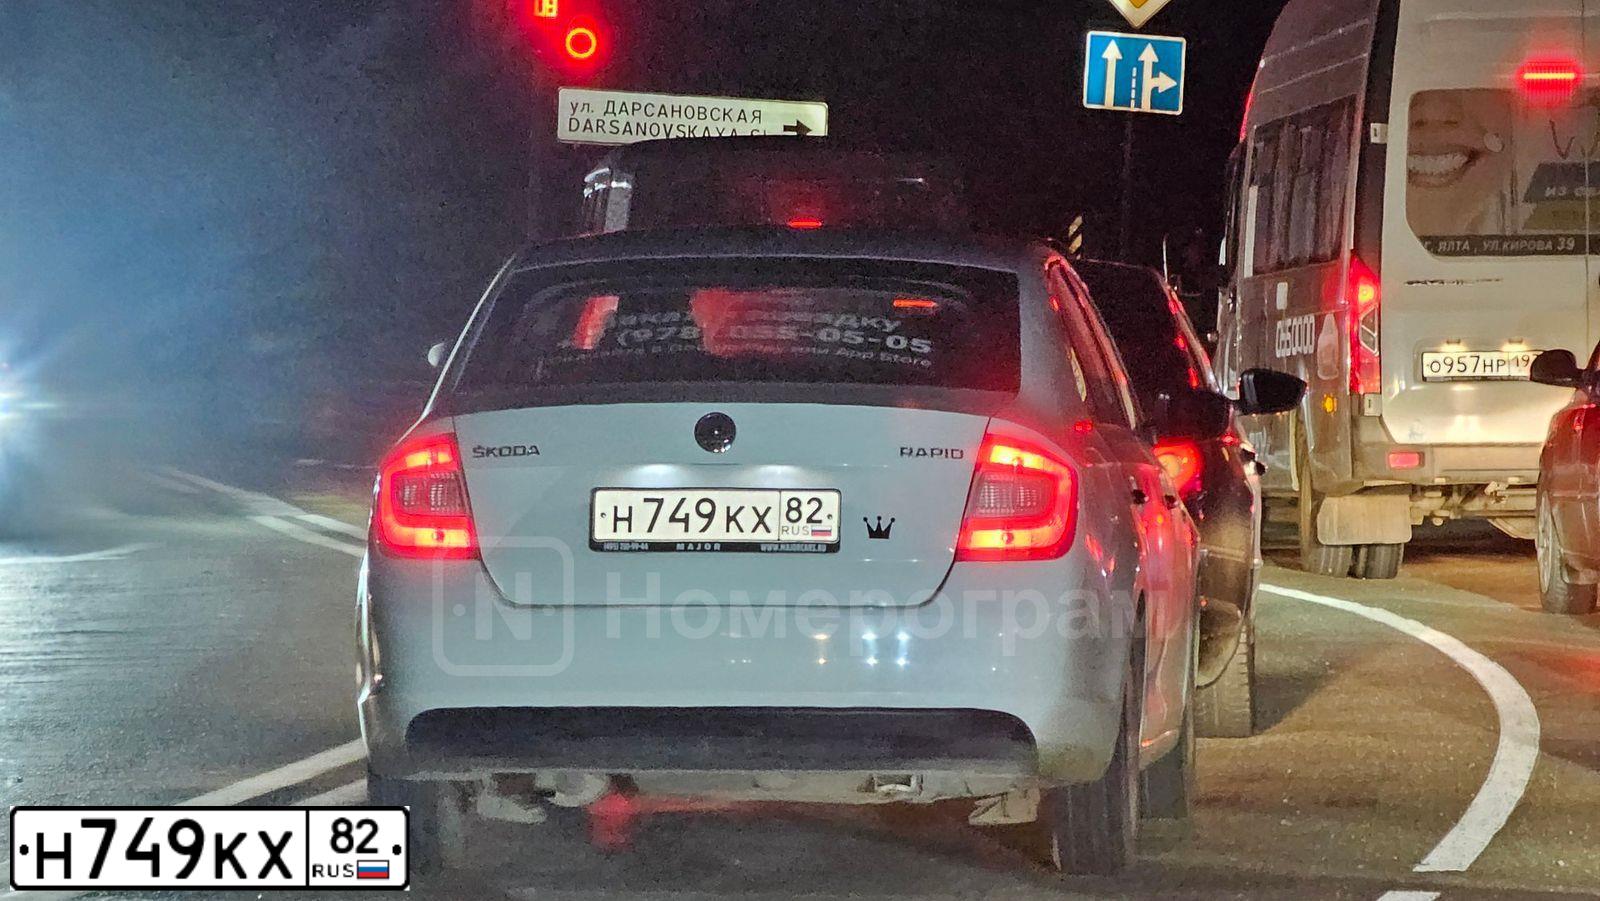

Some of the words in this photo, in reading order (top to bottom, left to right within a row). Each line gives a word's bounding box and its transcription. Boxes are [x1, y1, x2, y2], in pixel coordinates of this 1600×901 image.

[570, 101, 594, 116] ул.
[603, 100, 762, 124] ДАРСАНОВСКАЯ
[1502, 240, 1553, 251] КИРОВА
[1557, 237, 1575, 251] 39
[1511, 353, 1540, 368] 19
[472, 445, 540, 458] ŠKODA
[900, 446, 964, 460] RAPID
[612, 497, 772, 533] Н749КХ
[785, 497, 823, 524] 82
[781, 525, 810, 535] RUS
[676, 543, 721, 551] MAJOR
